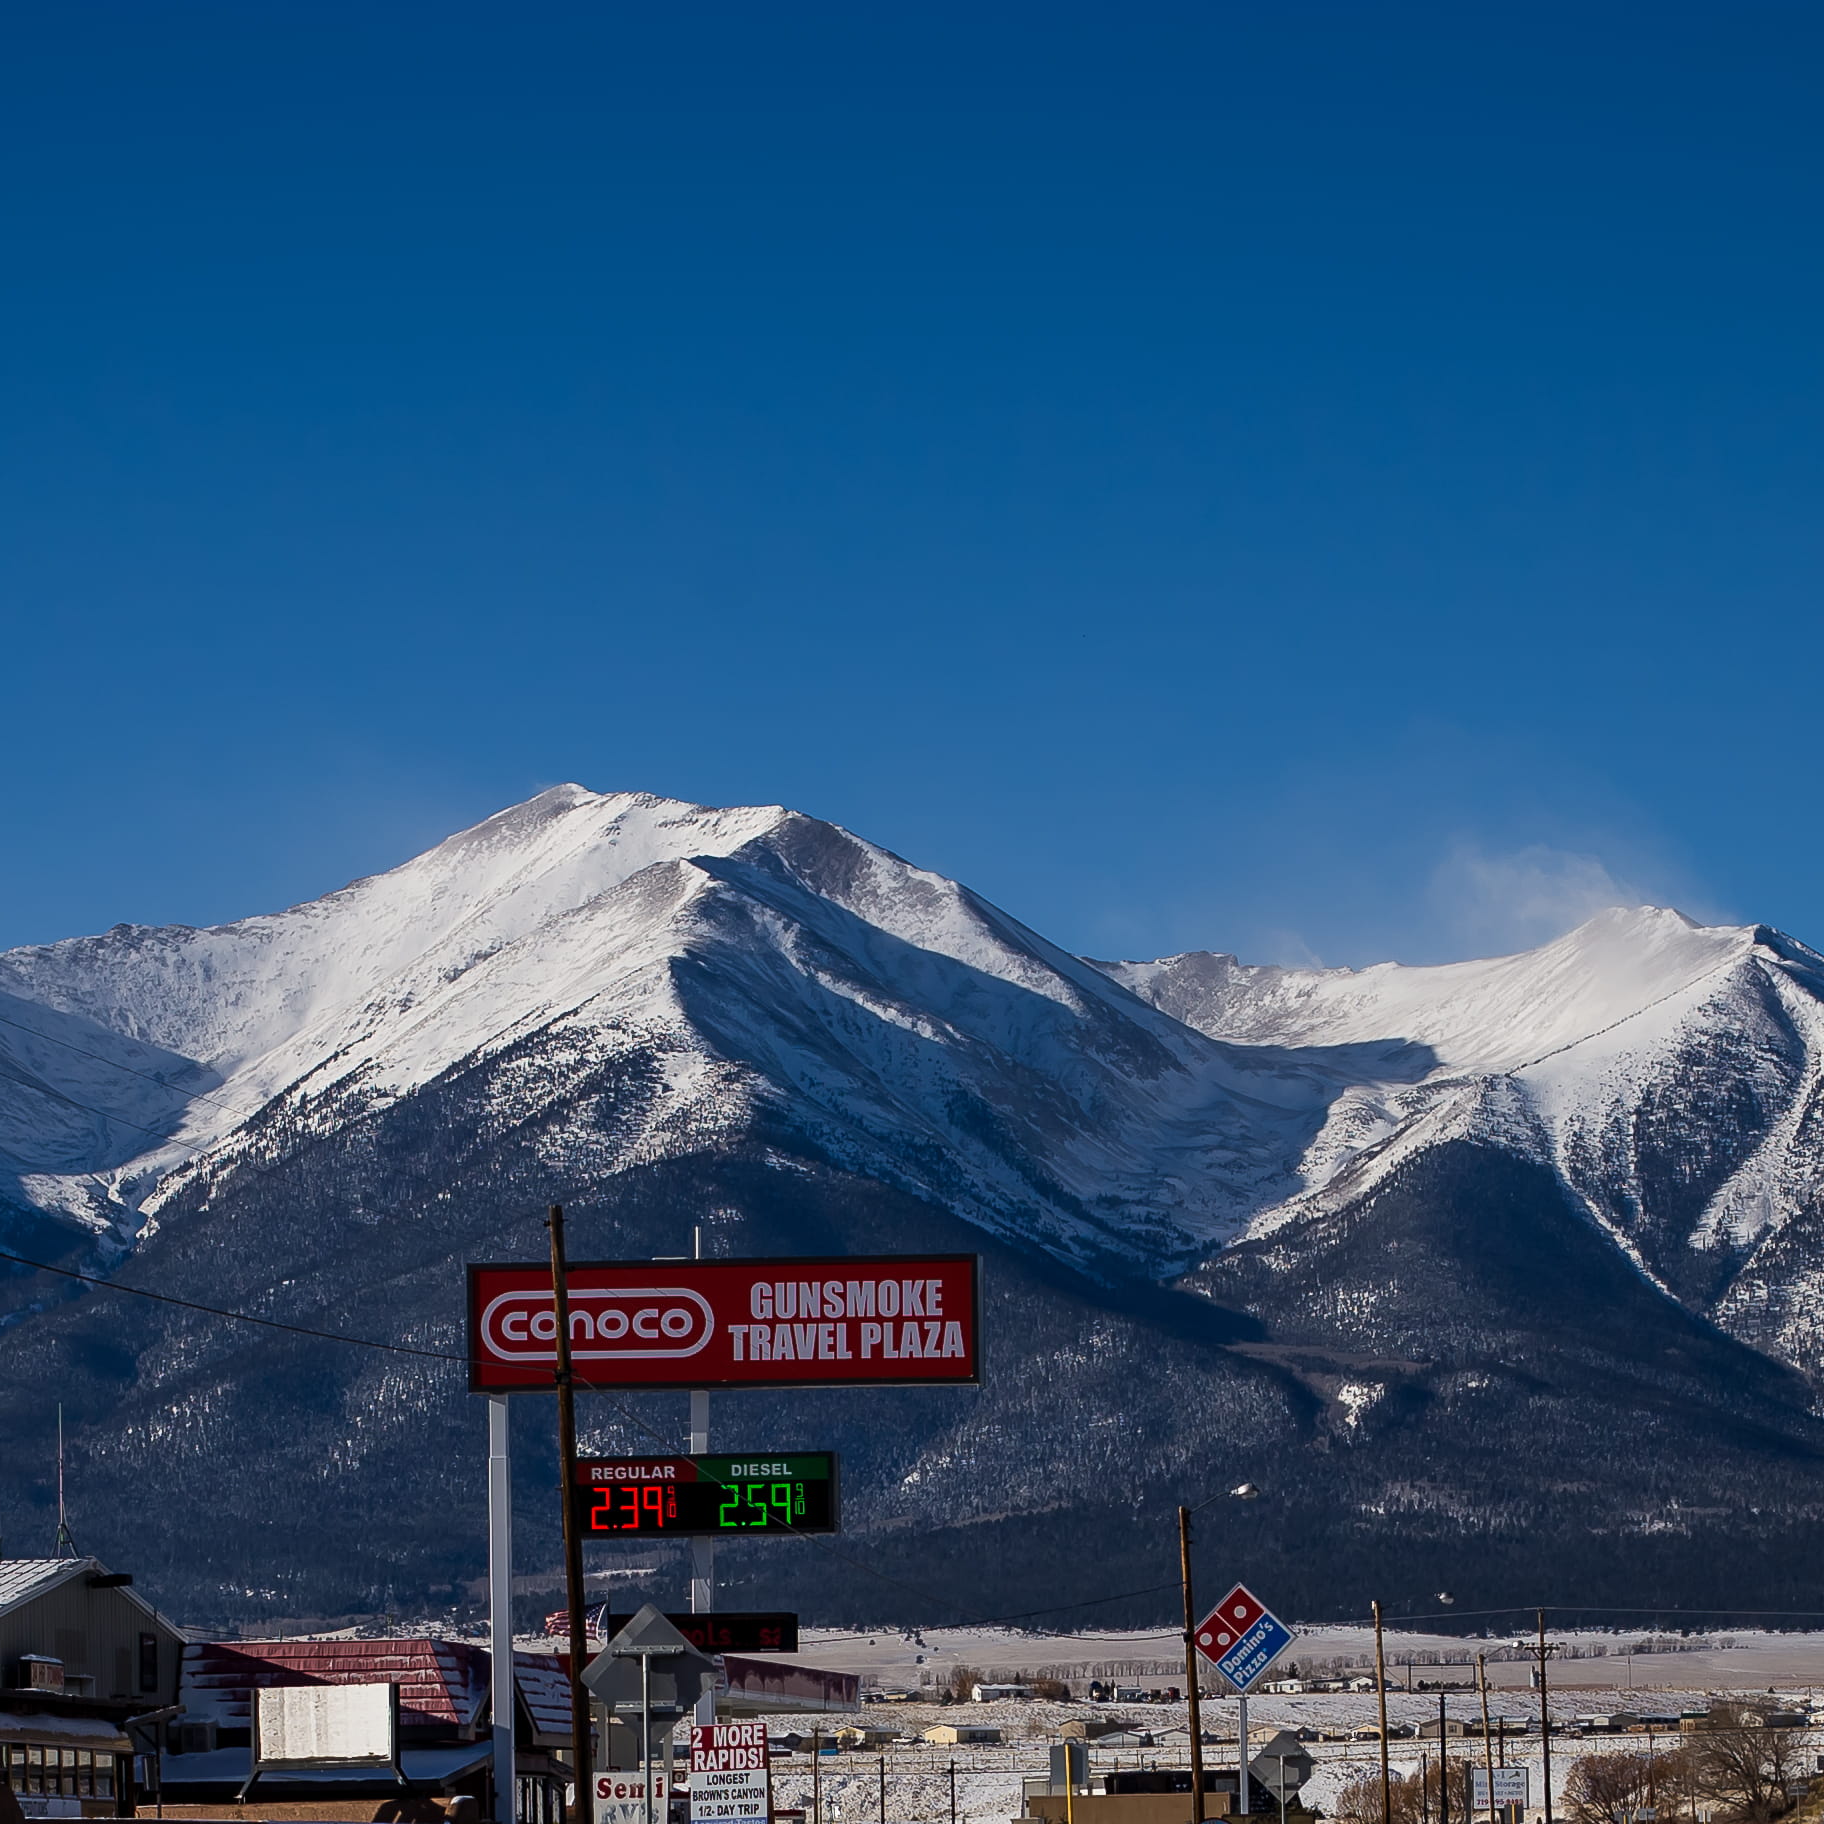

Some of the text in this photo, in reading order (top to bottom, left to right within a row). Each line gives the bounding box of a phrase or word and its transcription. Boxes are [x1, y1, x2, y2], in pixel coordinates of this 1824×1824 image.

[749, 1279, 944, 1320] GUNSMOKE
[727, 1319, 966, 1361] TRAVEL PLAZA
[591, 1465, 676, 1480] REGULAR
[730, 1463, 793, 1477] DIESEL
[591, 1485, 664, 1530] 2.39
[719, 1482, 793, 1527] 2.59
[1221, 1621, 1274, 1674] Domino's
[1233, 1651, 1268, 1685] Pizza
[692, 1725, 765, 1749] 2 MORE
[693, 1747, 764, 1771] RAPIDS!
[596, 1776, 664, 1799] Semi
[706, 1773, 750, 1786] LONGEST
[1494, 1780, 1526, 1789] Storage
[692, 1787, 765, 1802] BROWN'S CANYON
[717, 1804, 735, 1816] DAY
[738, 1803, 760, 1815] TRIP
